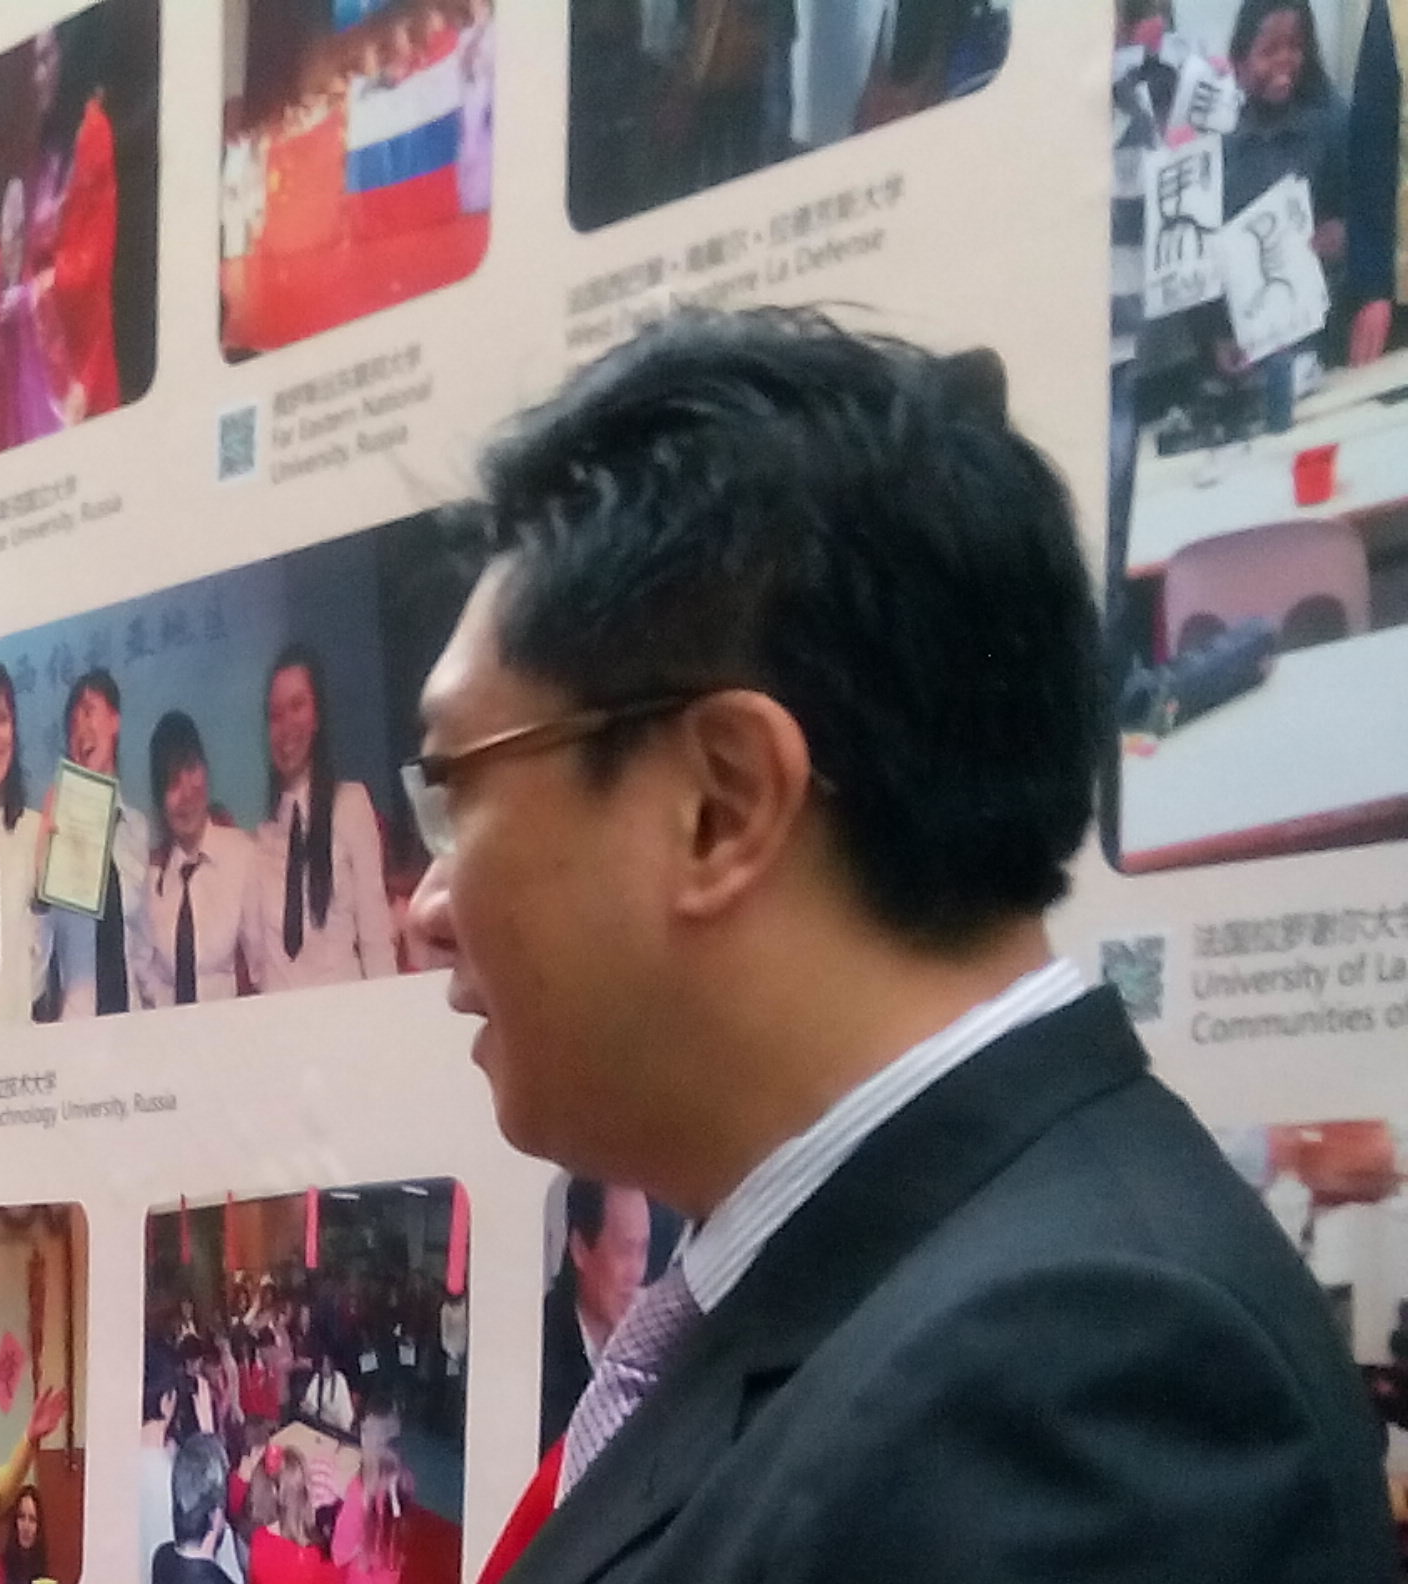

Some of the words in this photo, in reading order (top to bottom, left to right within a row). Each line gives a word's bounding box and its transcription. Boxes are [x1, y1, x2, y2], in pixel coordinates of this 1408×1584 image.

[1190, 956, 1330, 1001] University
[1336, 950, 1368, 988] of
[1190, 1004, 1377, 1047] Communities
[133, 1091, 178, 1114] Russia
